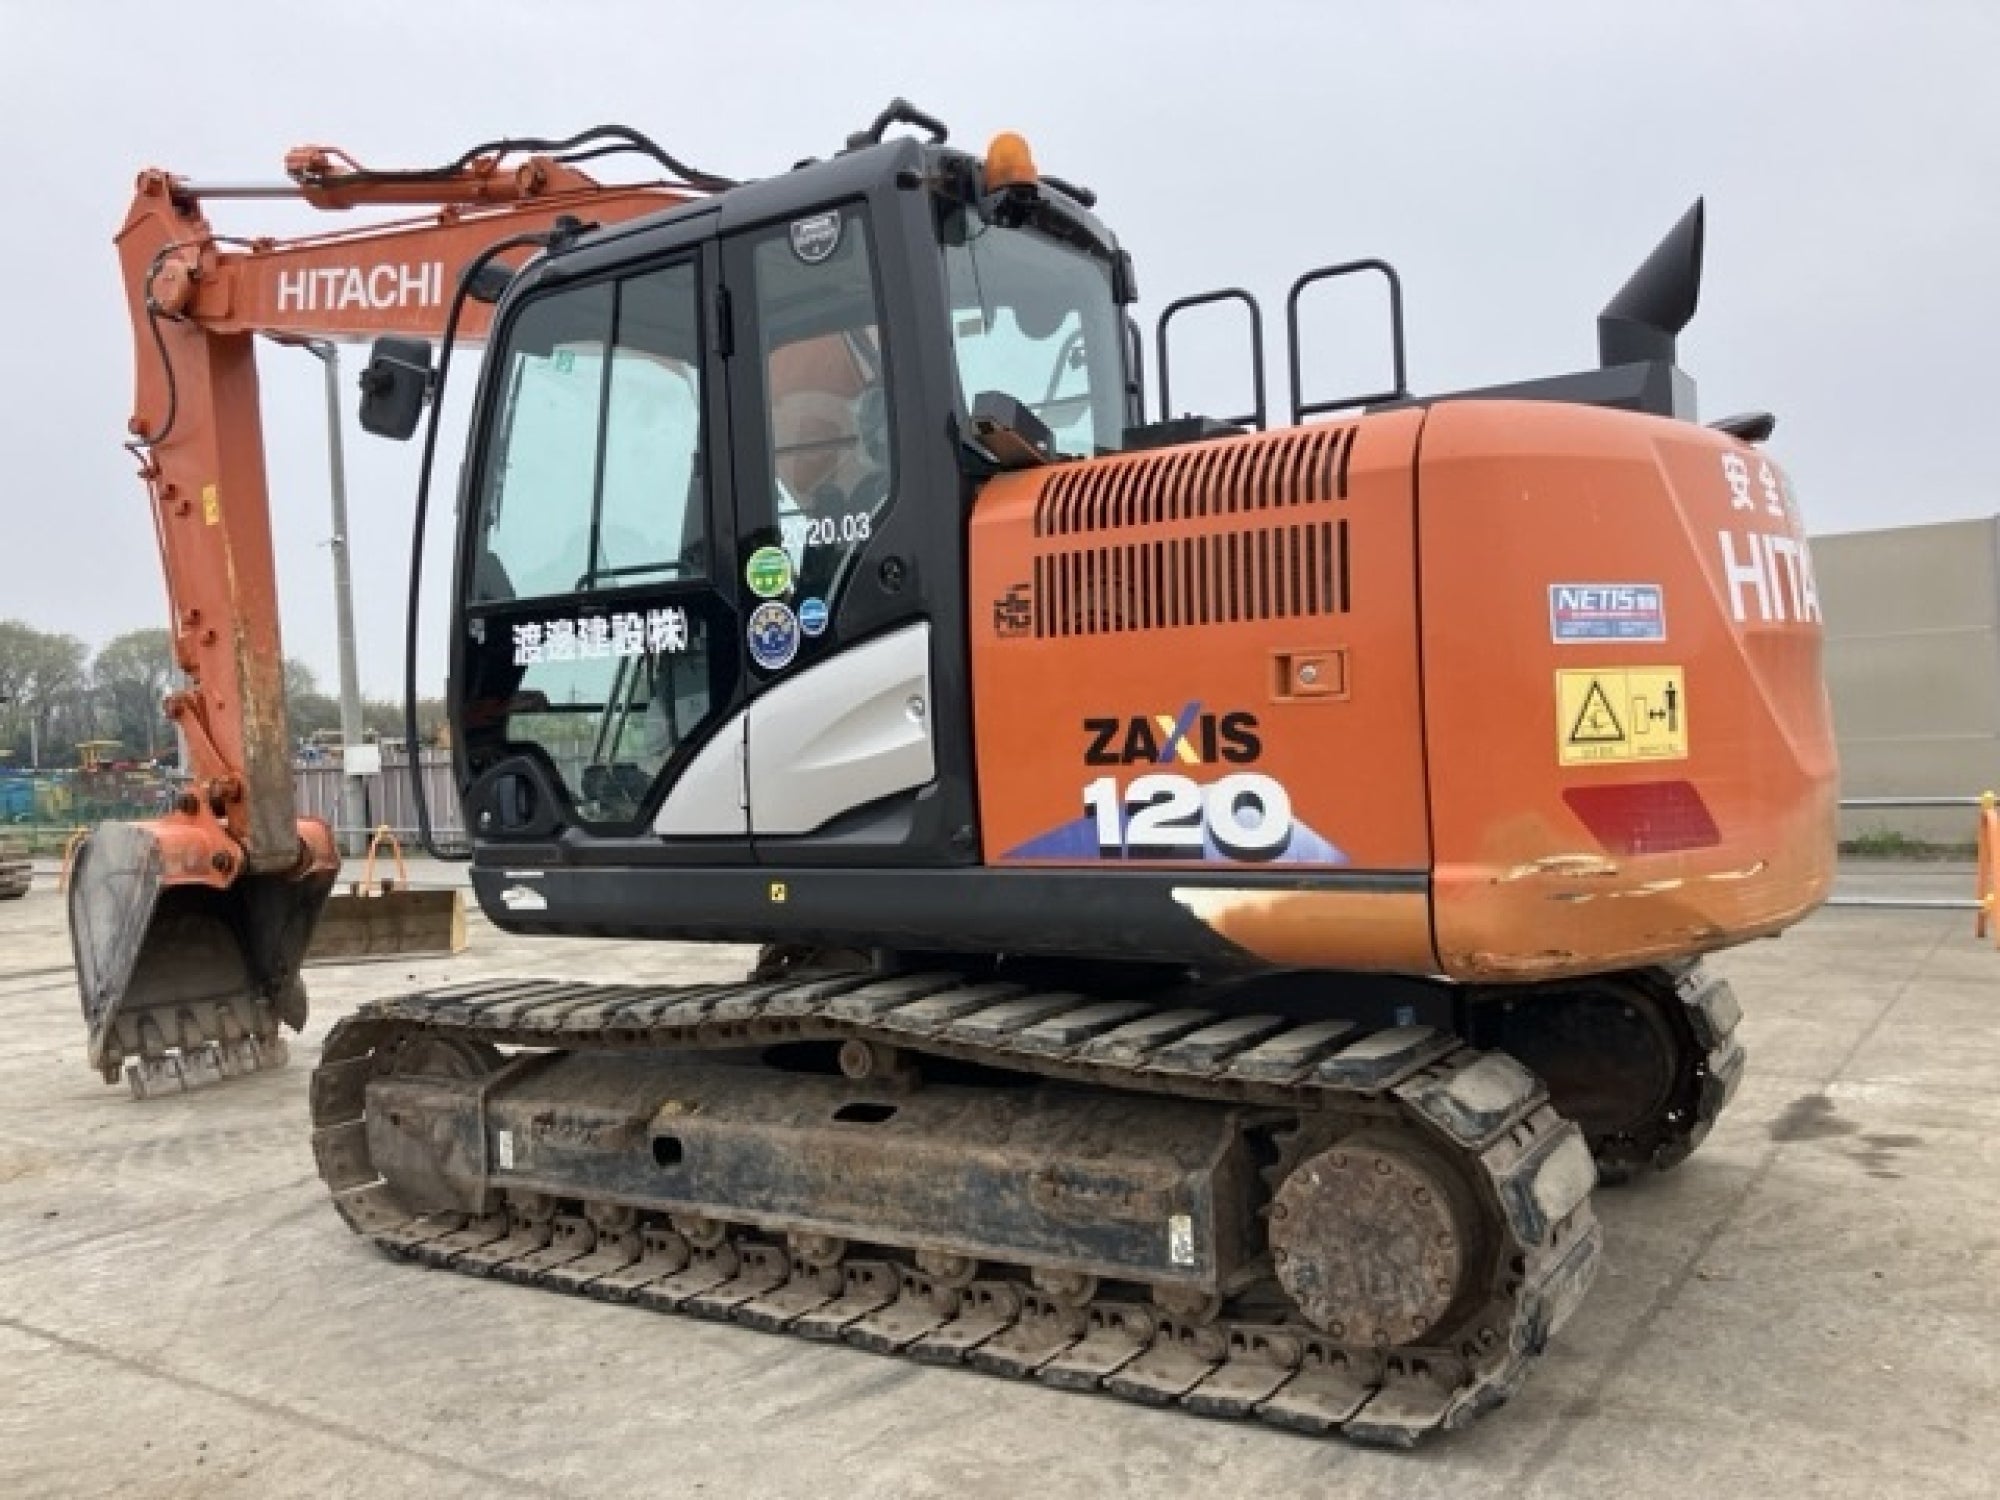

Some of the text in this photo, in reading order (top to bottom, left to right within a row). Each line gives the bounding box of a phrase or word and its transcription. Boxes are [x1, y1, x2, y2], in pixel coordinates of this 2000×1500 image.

[277, 262, 444, 312] HITACHI
[1083, 699, 1263, 766] ZAXIS
[1083, 772, 1293, 862] 120
